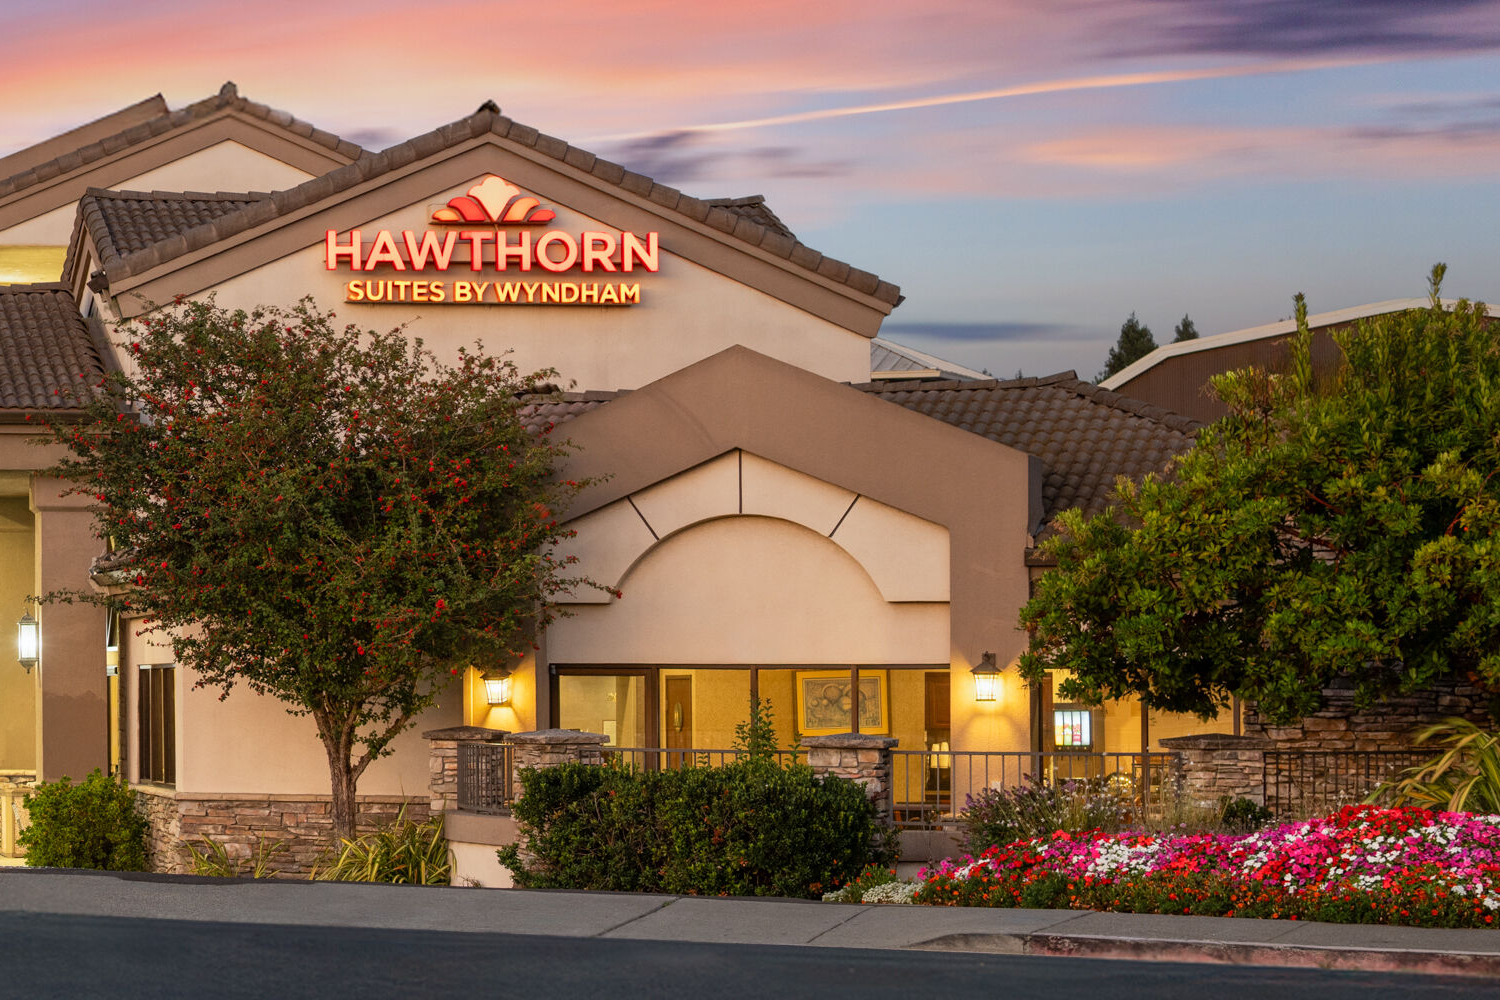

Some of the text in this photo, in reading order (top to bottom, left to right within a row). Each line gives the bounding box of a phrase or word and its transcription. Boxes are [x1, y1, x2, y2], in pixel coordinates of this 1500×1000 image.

[326, 229, 659, 273] HAWTHORN
[347, 280, 641, 304] SUITES BY WYNDHAM
